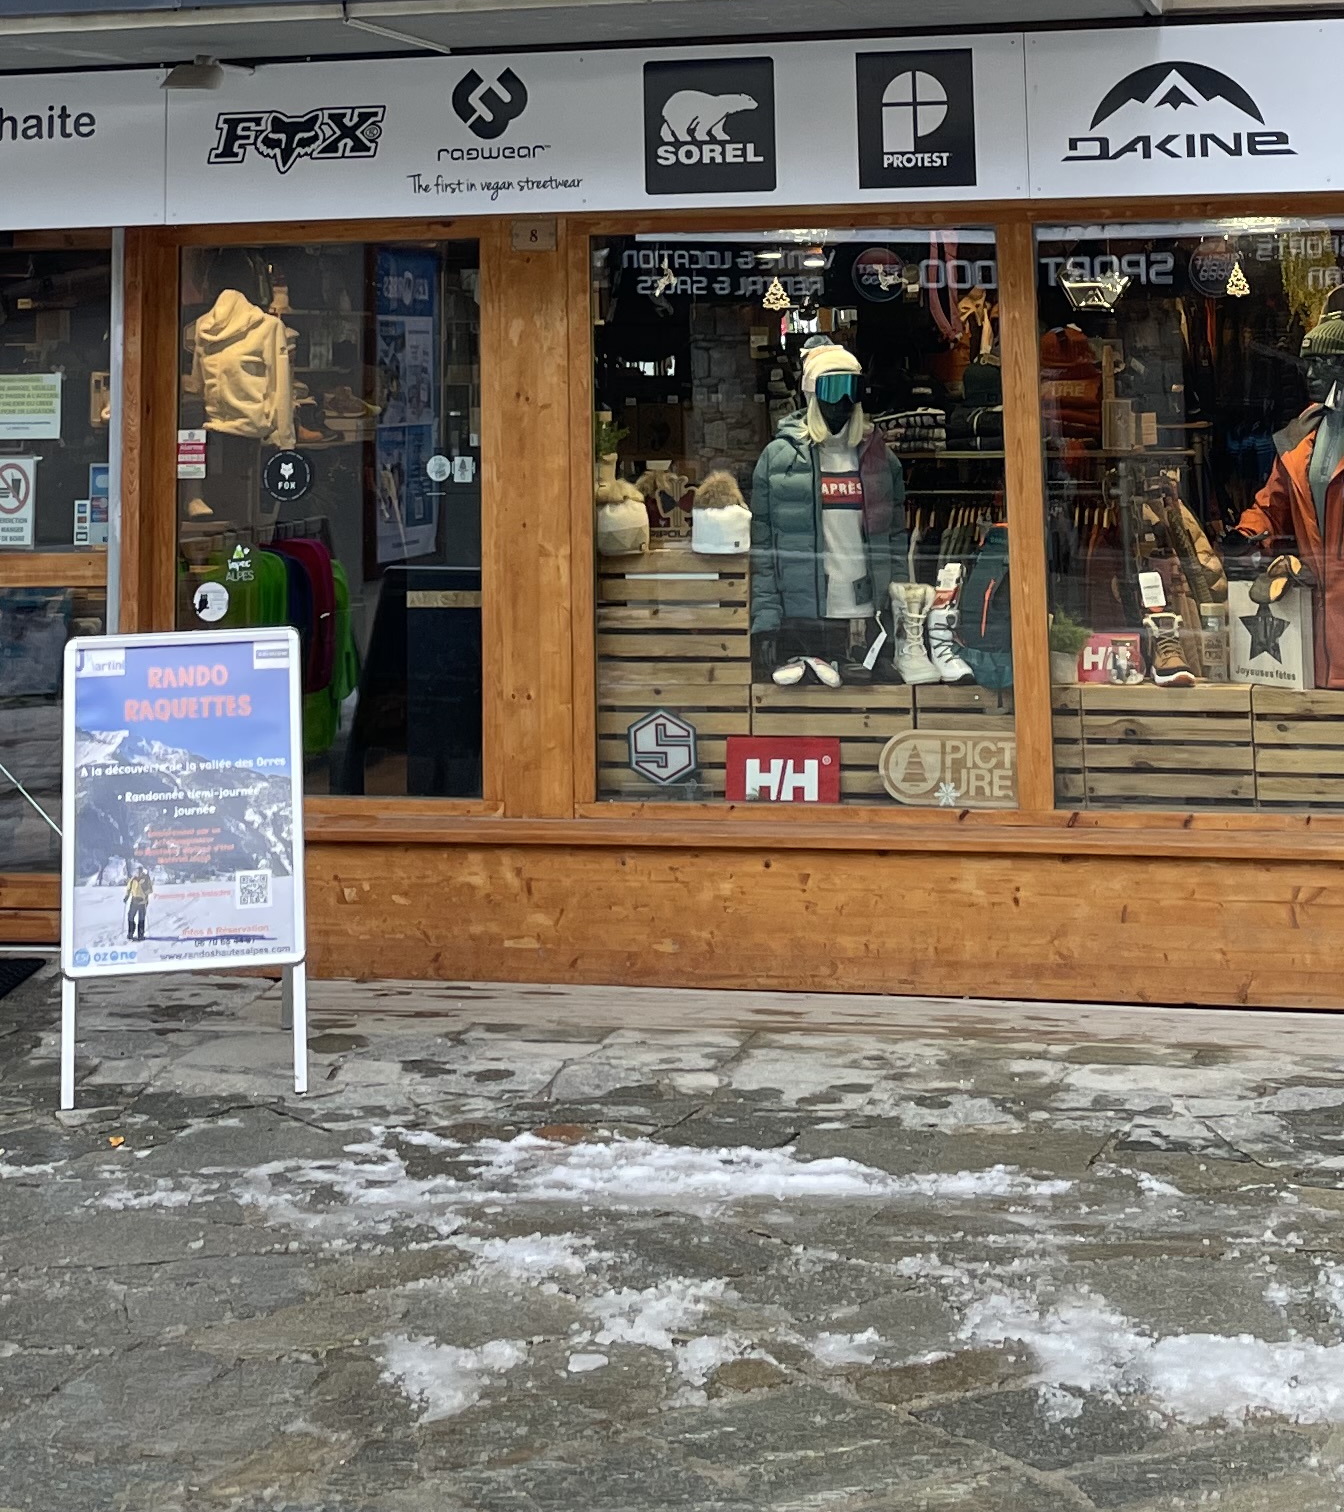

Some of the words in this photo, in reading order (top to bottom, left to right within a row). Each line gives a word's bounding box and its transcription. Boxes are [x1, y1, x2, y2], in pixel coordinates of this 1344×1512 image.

[656, 142, 764, 166] SOREL
[1061, 130, 1299, 162] DAKINE
[882, 151, 950, 168] PROTEST
[406, 174, 431, 194] The
[434, 175, 466, 193] first
[467, 174, 478, 192] in
[480, 179, 515, 200] vegan
[517, 174, 584, 191] streetwear
[529, 229, 539, 243] 8
[277, 481, 296, 490] FOX
[147, 664, 229, 689] RANDO
[124, 694, 253, 723] RAQUETTES
[91, 766, 102, 777] la
[105, 762, 168, 776] découverte
[169, 761, 182, 771] de
[185, 761, 197, 772] la
[199, 758, 232, 771] vallée
[234, 757, 254, 768] des
[256, 756, 287, 768] Orres
[944, 740, 1016, 769] PICT
[745, 758, 819, 801] HH
[125, 789, 185, 803] Randonnée
[187, 786, 260, 800] demi-journée
[173, 805, 217, 819] journée
